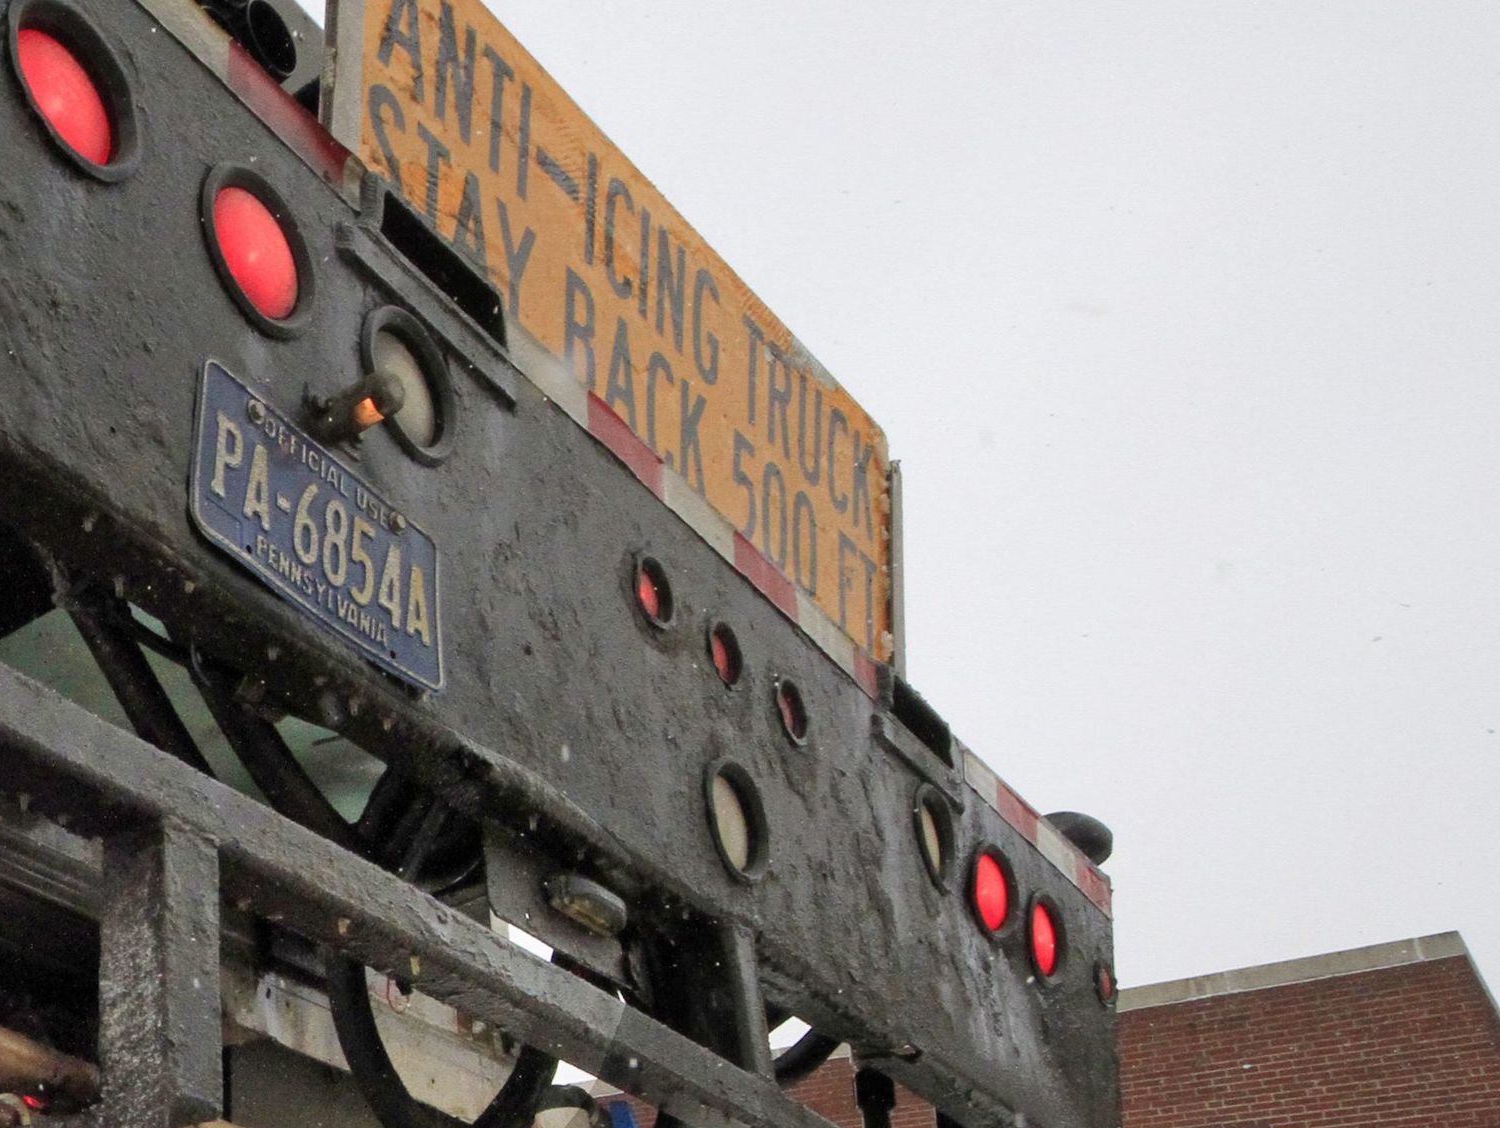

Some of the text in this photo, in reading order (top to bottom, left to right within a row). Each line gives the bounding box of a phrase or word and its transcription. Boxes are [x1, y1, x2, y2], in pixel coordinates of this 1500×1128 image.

[368, 83, 877, 655] STAY BACK 500 FT
[377, 0, 874, 542] ANTI-ICING TRUCK
[210, 408, 431, 648] PA-6854A
[255, 534, 389, 647] PENNSYLVANIA
[263, 416, 390, 531] OFFICIAL USE
